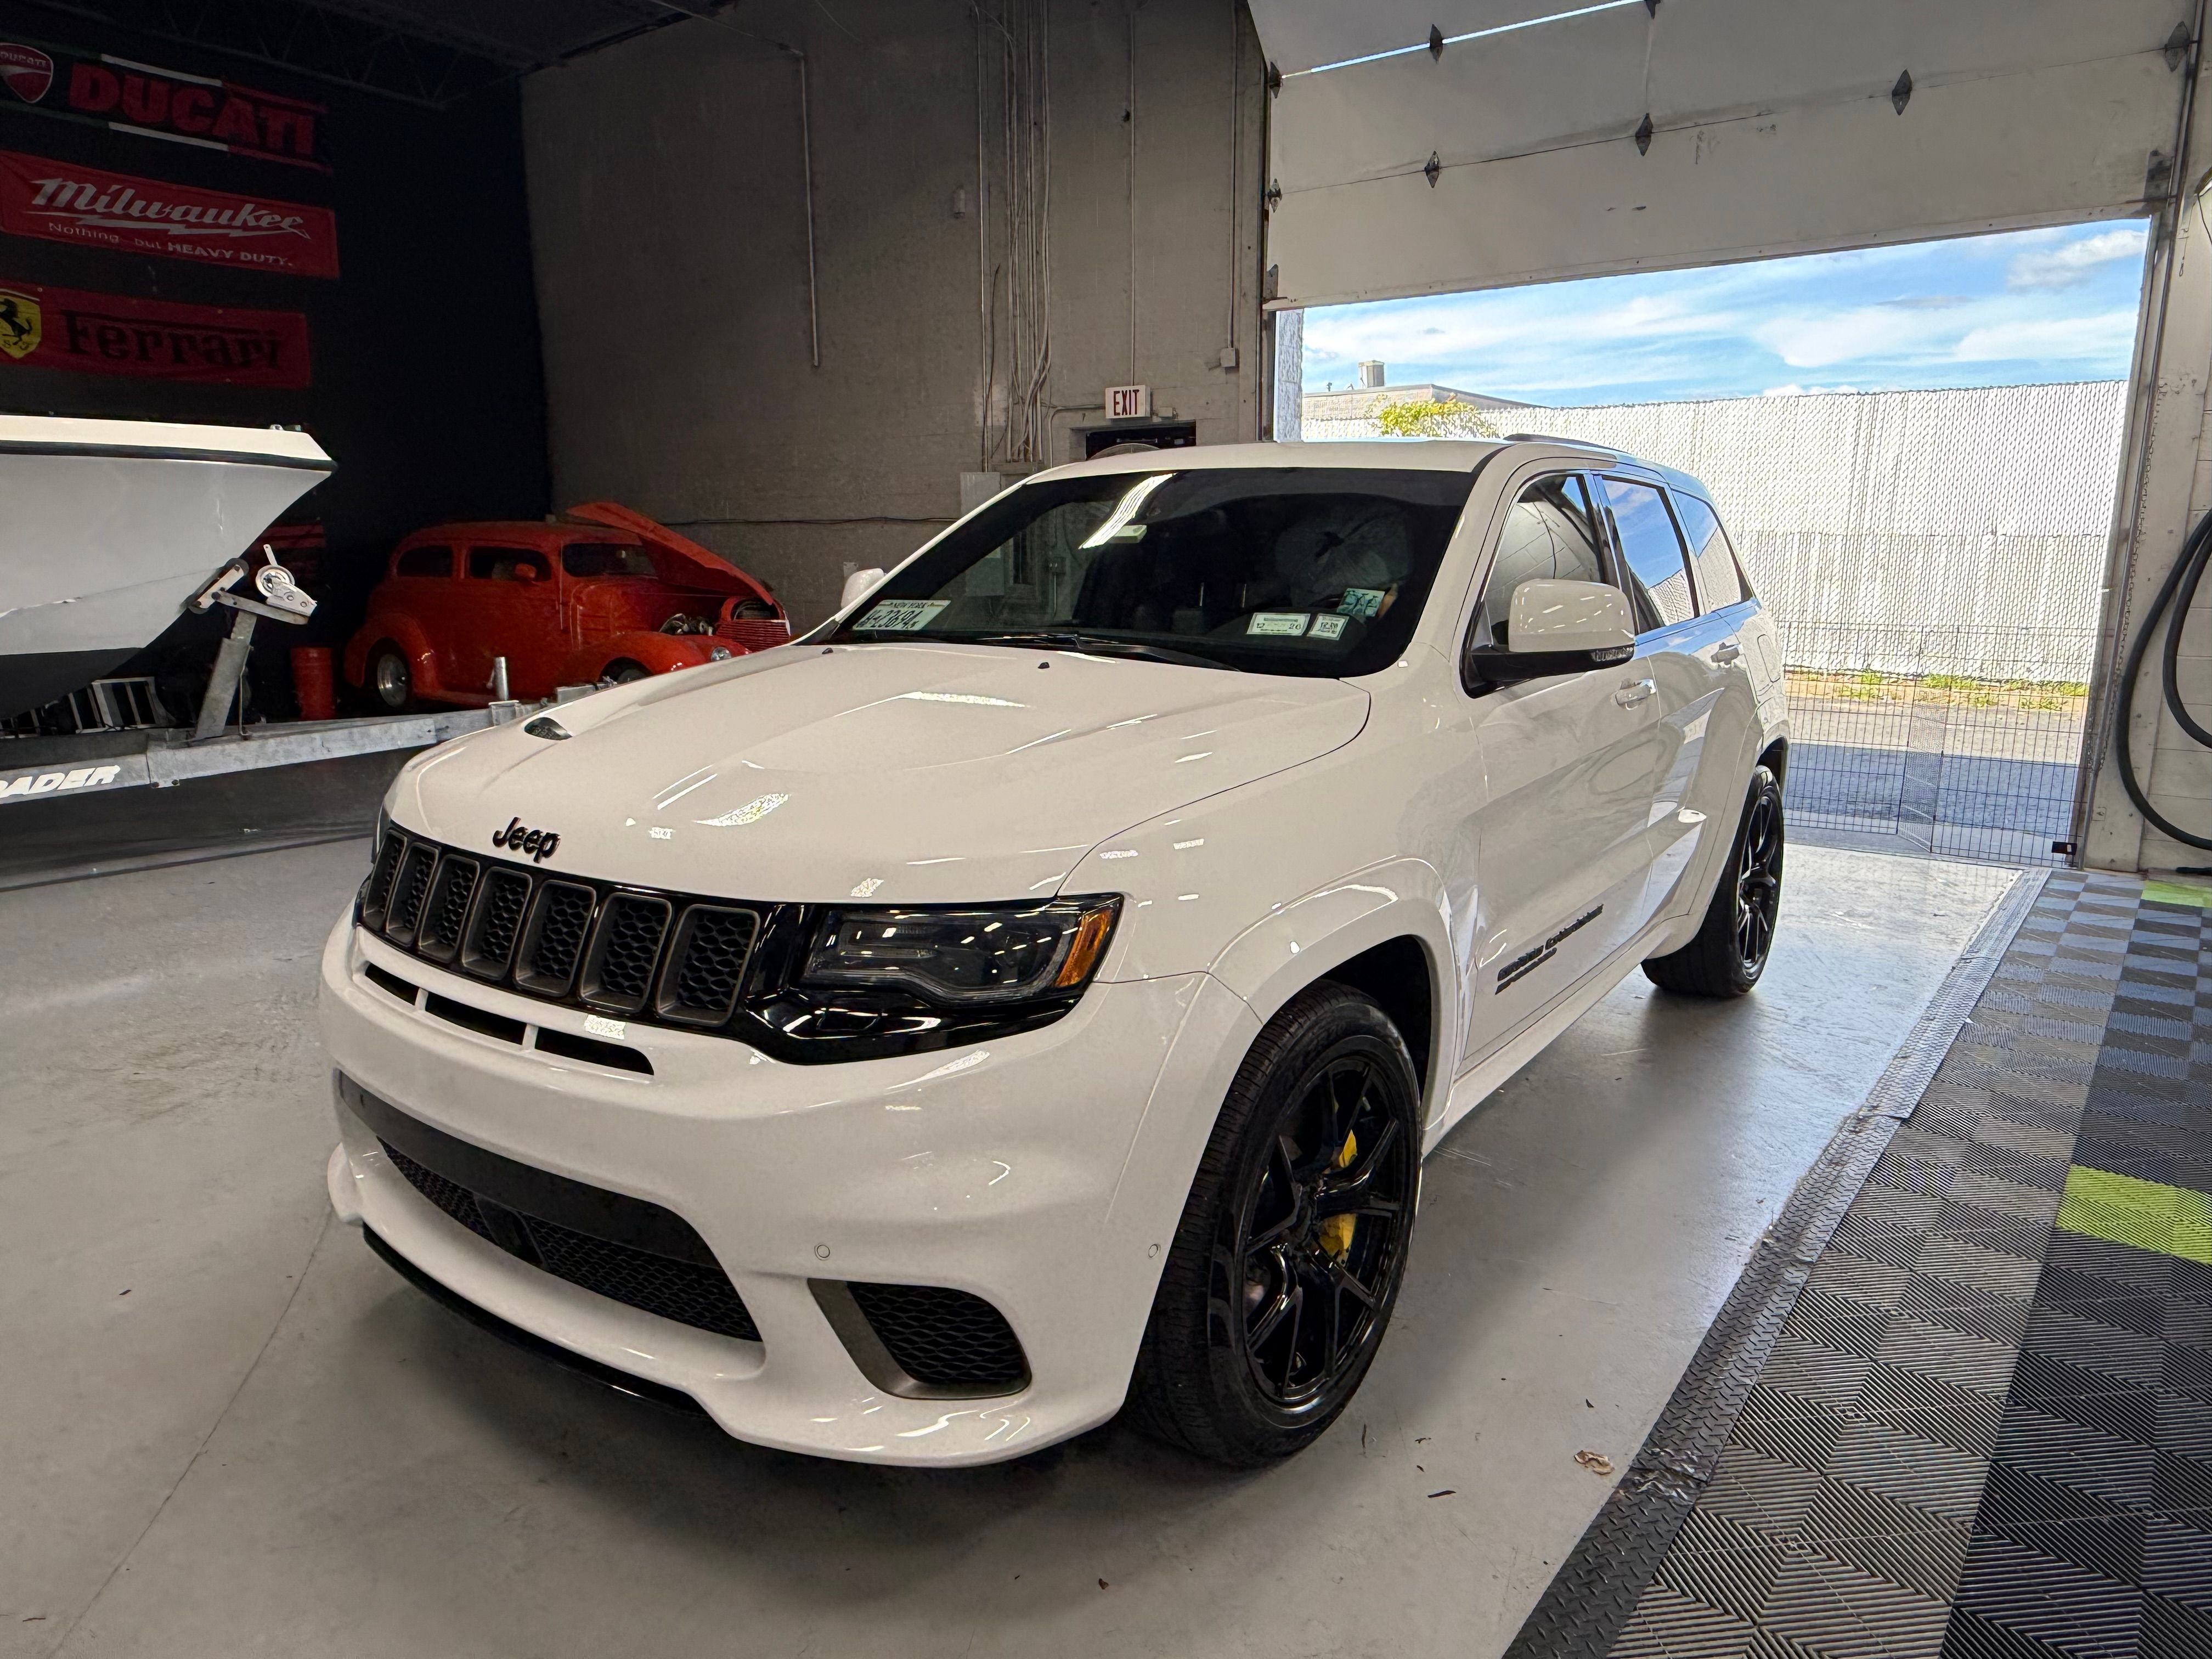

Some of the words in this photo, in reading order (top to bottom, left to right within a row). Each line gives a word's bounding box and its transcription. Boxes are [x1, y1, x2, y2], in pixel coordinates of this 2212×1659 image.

[69, 62, 314, 155] DUCATI
[30, 177, 311, 240] Milwaukee
[49, 222, 120, 243] Nothing
[167, 241, 234, 258] HEAVY
[60, 309, 282, 369] Ferrari
[1113, 389, 1140, 416] EXIT
[0, 765, 121, 799] ADER
[493, 817, 561, 864] Jeep
